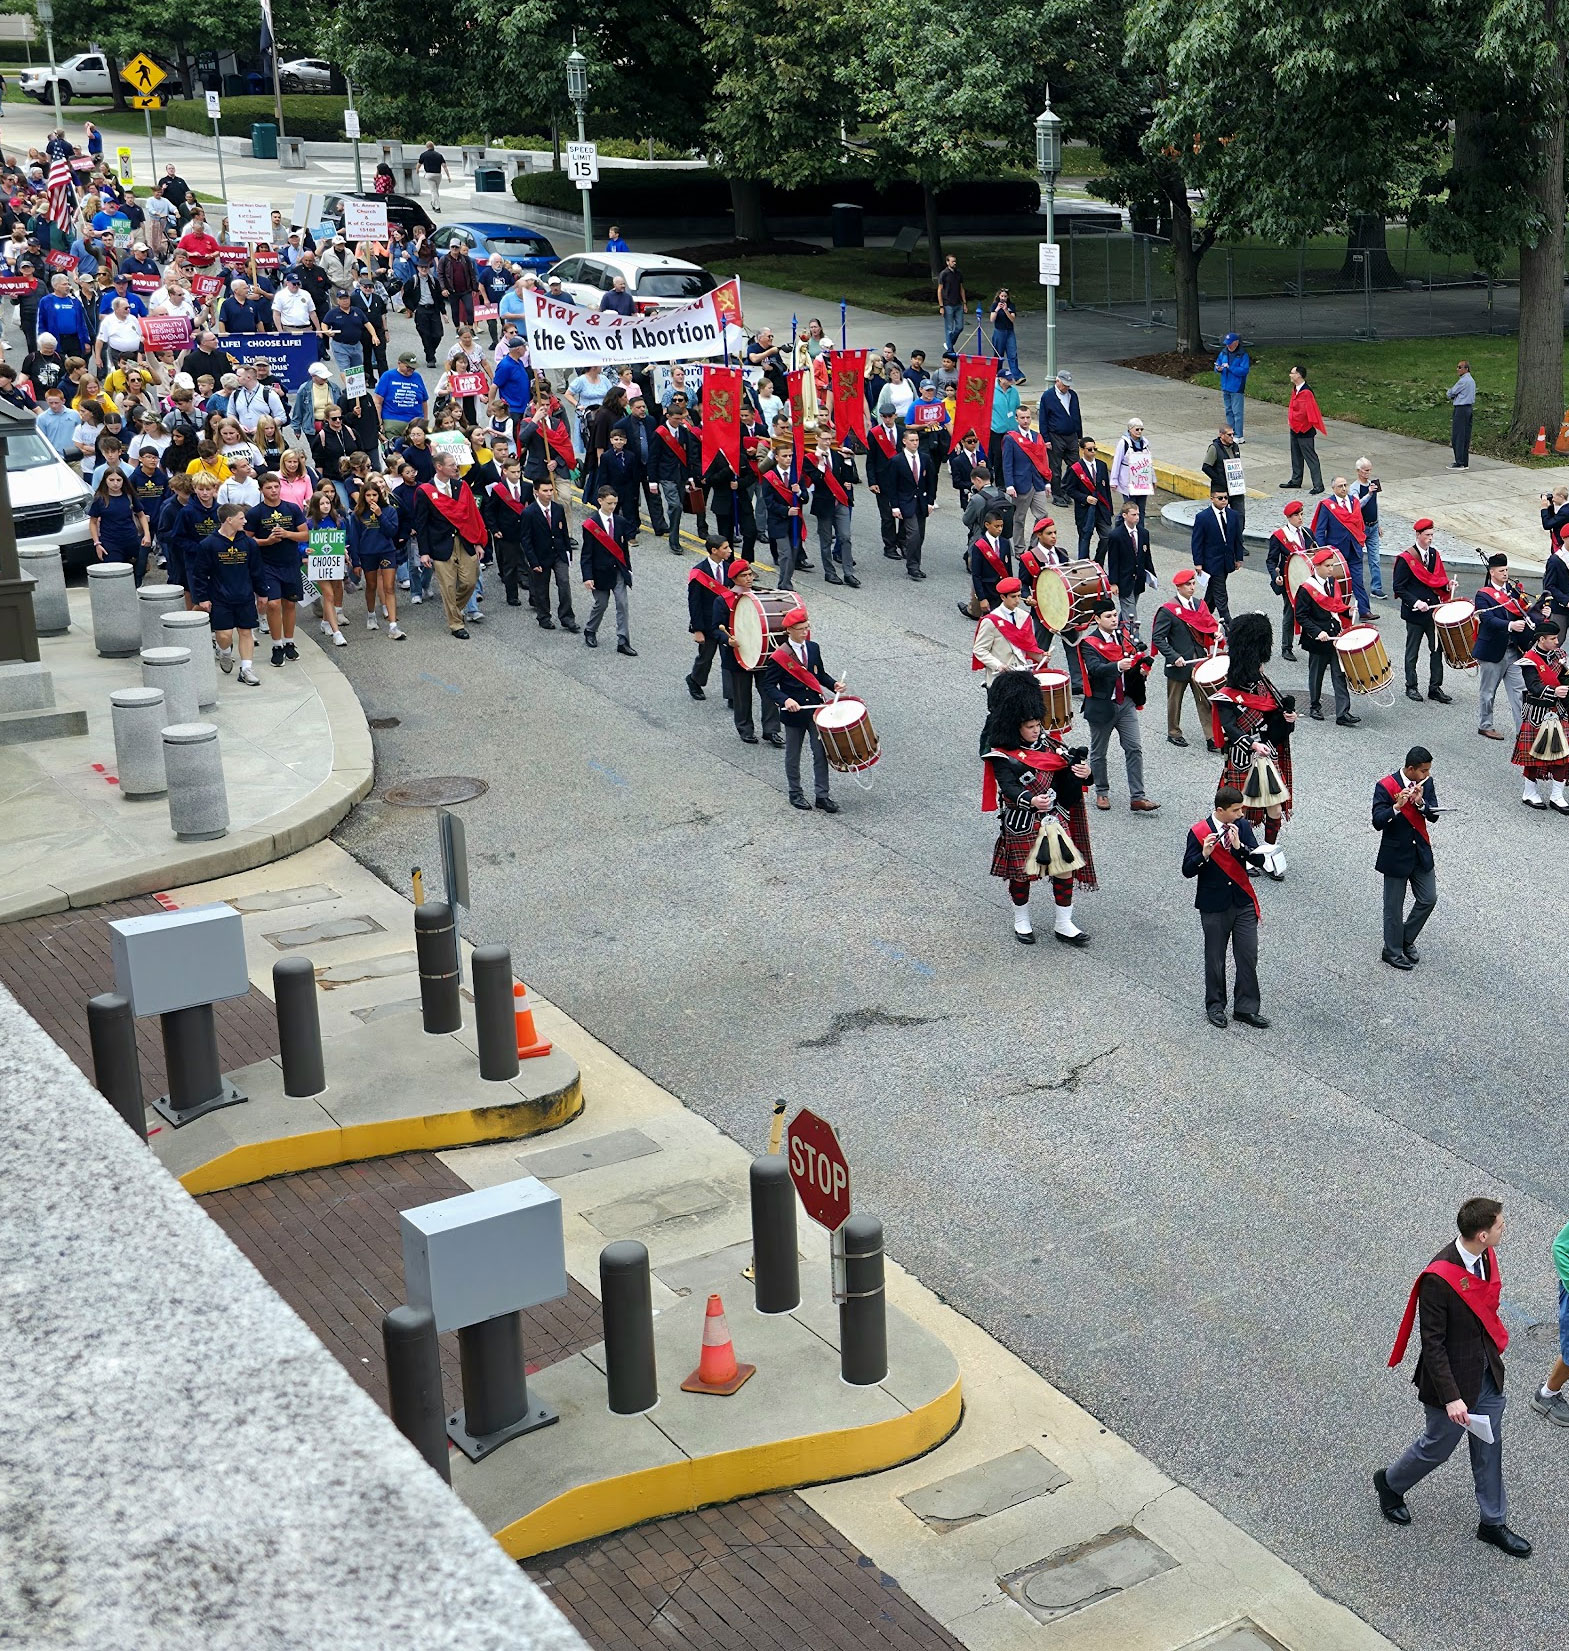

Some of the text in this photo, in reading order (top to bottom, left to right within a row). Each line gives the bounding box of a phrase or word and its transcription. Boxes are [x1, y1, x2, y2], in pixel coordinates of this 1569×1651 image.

[574, 162, 591, 176] 15
[536, 296, 580, 325] Pray
[586, 314, 600, 326] &
[534, 322, 715, 351] the Sin of Abortion
[310, 533, 344, 544] LOVE LIFE
[312, 557, 340, 567] CHOOSE
[319, 568, 333, 578] LIFE
[791, 1135, 846, 1201] STOP
